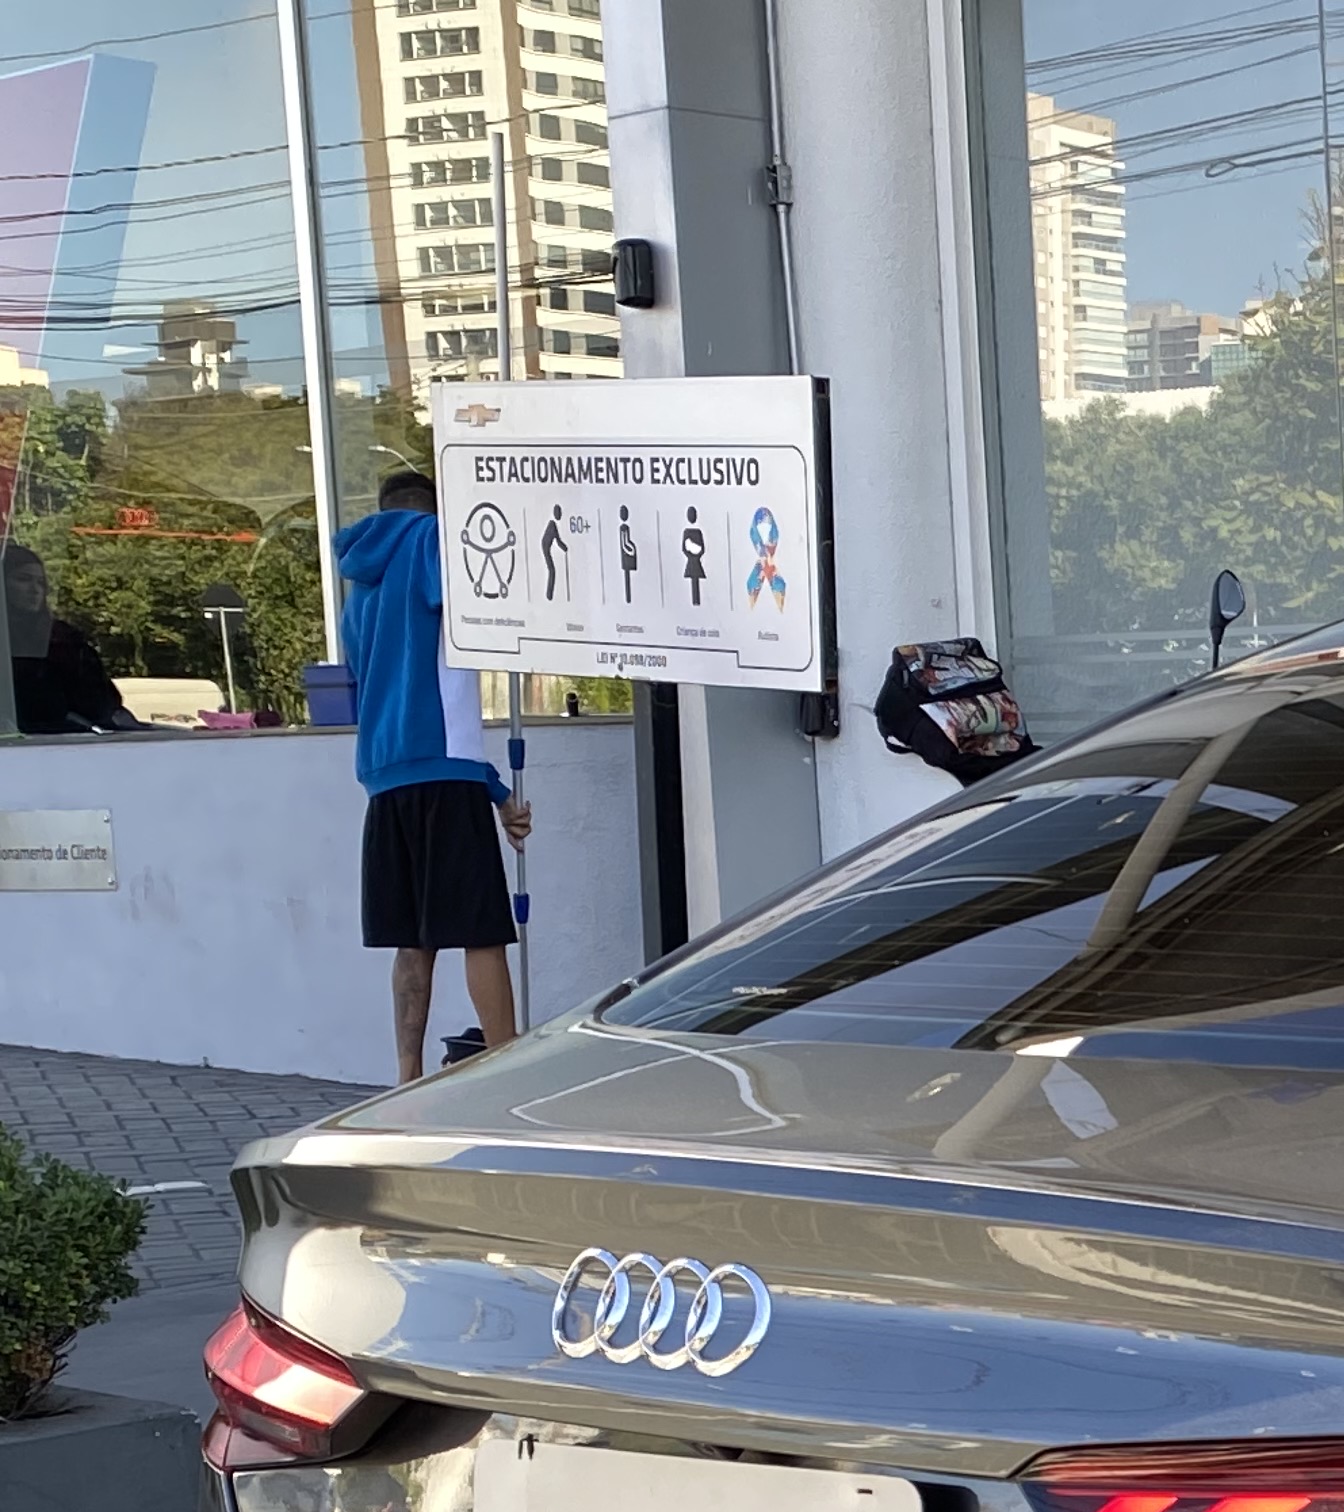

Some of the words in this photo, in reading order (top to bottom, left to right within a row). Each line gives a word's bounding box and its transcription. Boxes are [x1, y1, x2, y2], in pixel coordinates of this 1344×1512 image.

[475, 456, 644, 484] ESTACIONAMENTO
[650, 456, 760, 486] EXCLUSIVO
[569, 515, 591, 534] 60+
[55, 844, 68, 861] de
[70, 844, 107, 861] Cliente
